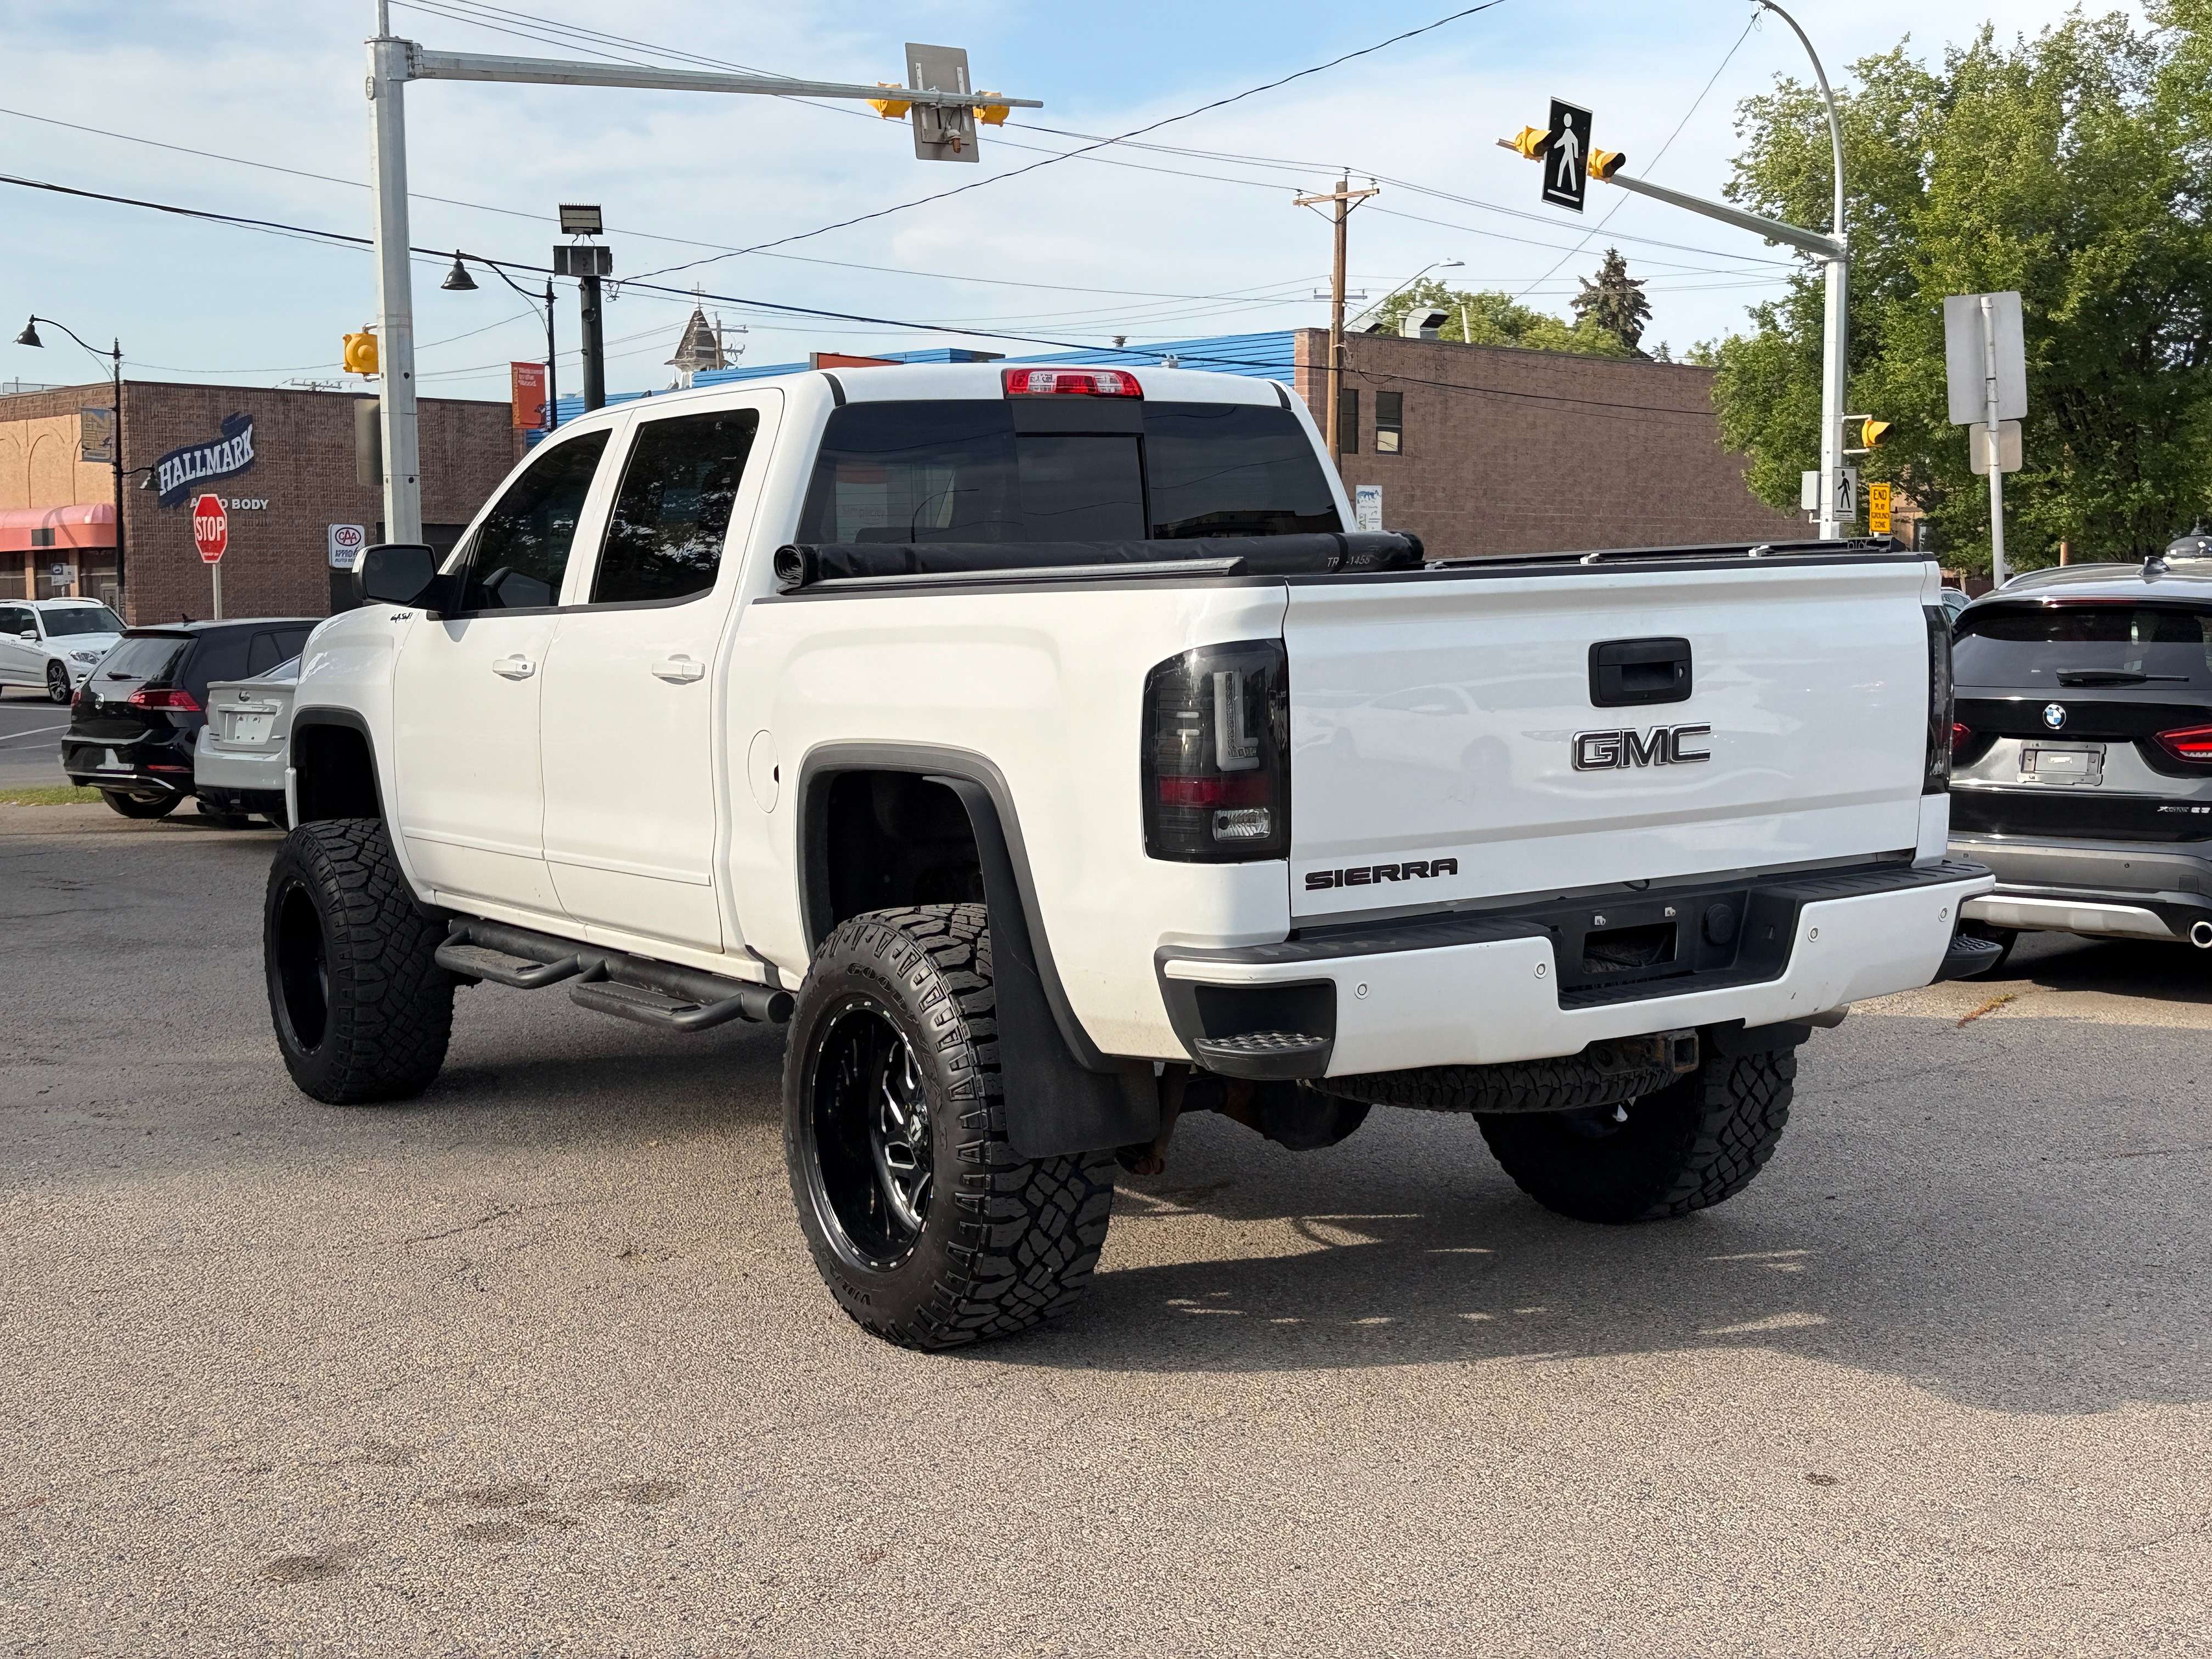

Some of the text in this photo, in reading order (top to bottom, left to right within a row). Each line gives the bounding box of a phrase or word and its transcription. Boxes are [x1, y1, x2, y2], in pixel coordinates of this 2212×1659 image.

[158, 424, 254, 496] HALLMARK
[190, 498, 269, 510] AO BODY
[1874, 489, 1887, 500] END
[195, 516, 225, 541] STOP
[338, 529, 357, 544] CAA
[1571, 721, 1711, 771] GMC
[1305, 857, 1459, 891] SIERRA
